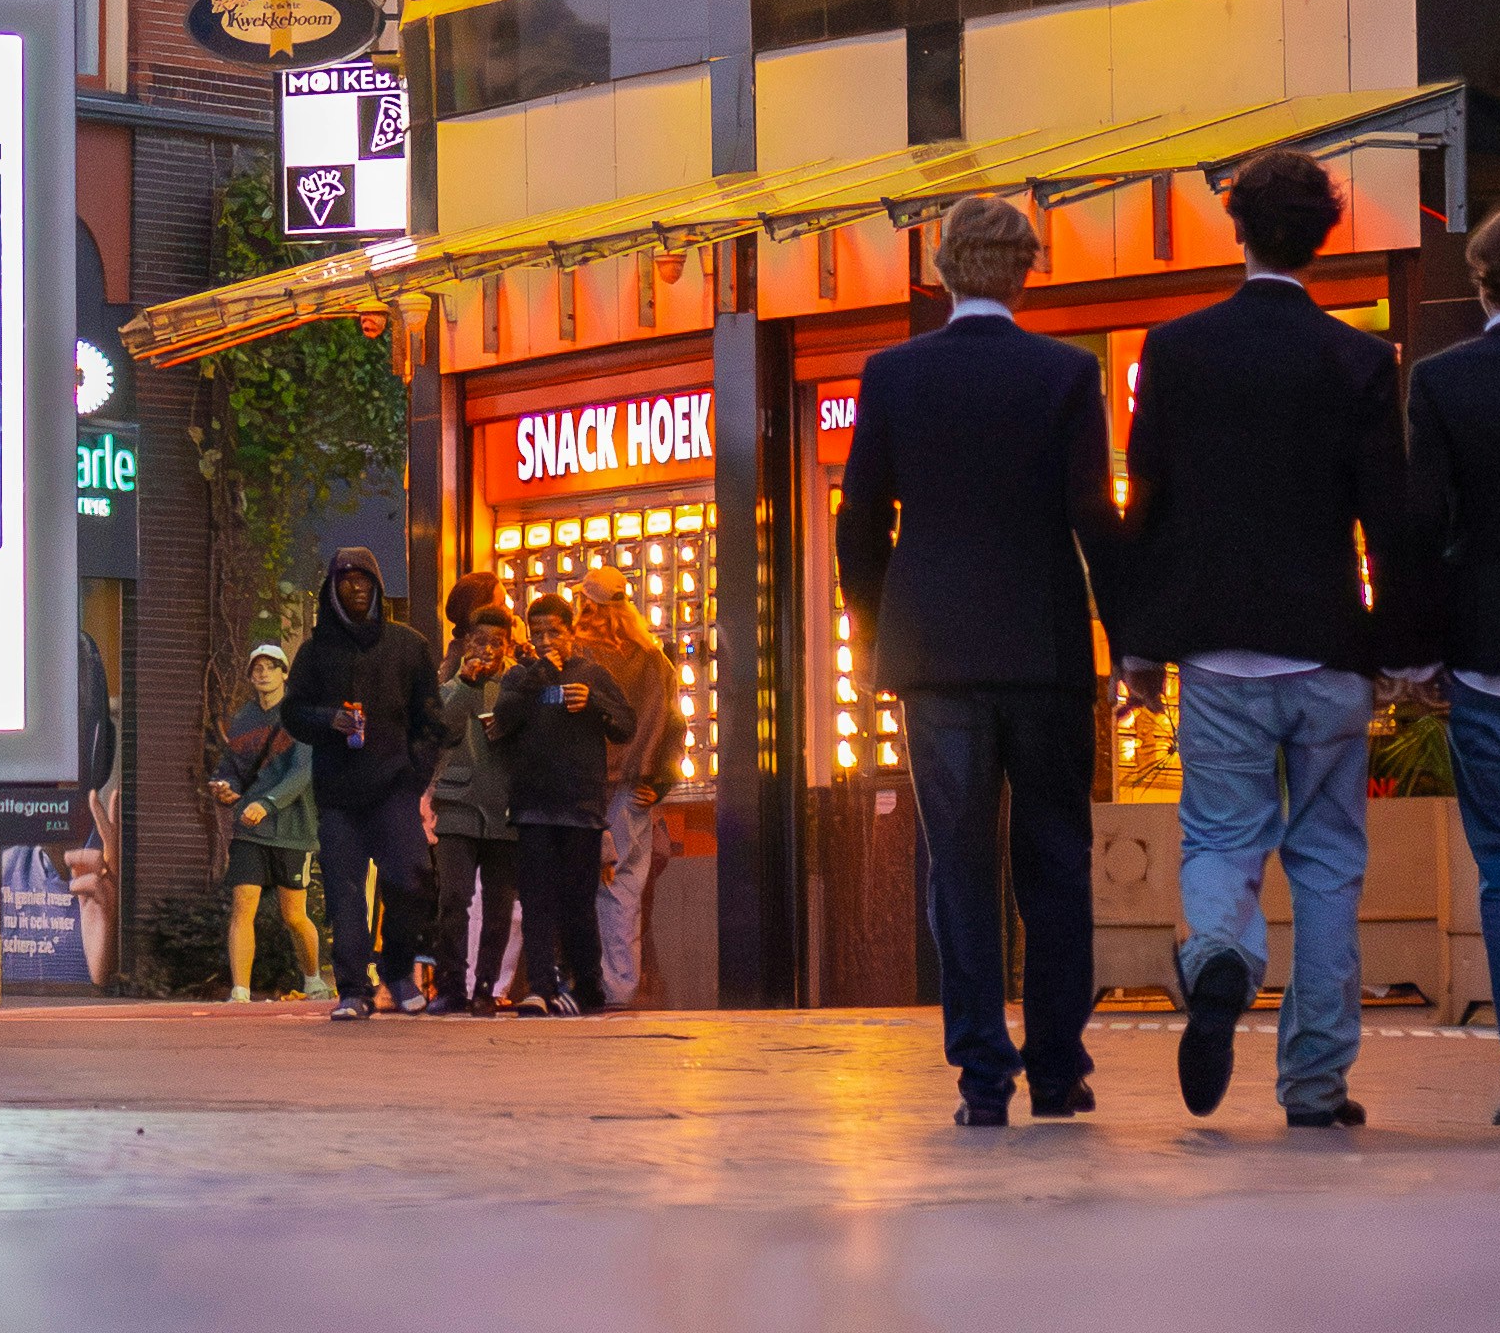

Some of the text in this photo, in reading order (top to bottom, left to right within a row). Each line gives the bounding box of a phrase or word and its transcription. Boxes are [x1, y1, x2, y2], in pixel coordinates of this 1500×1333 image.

[227, 8, 333, 31] Kwekkeboom
[517, 392, 713, 482] SNACK HOEK
